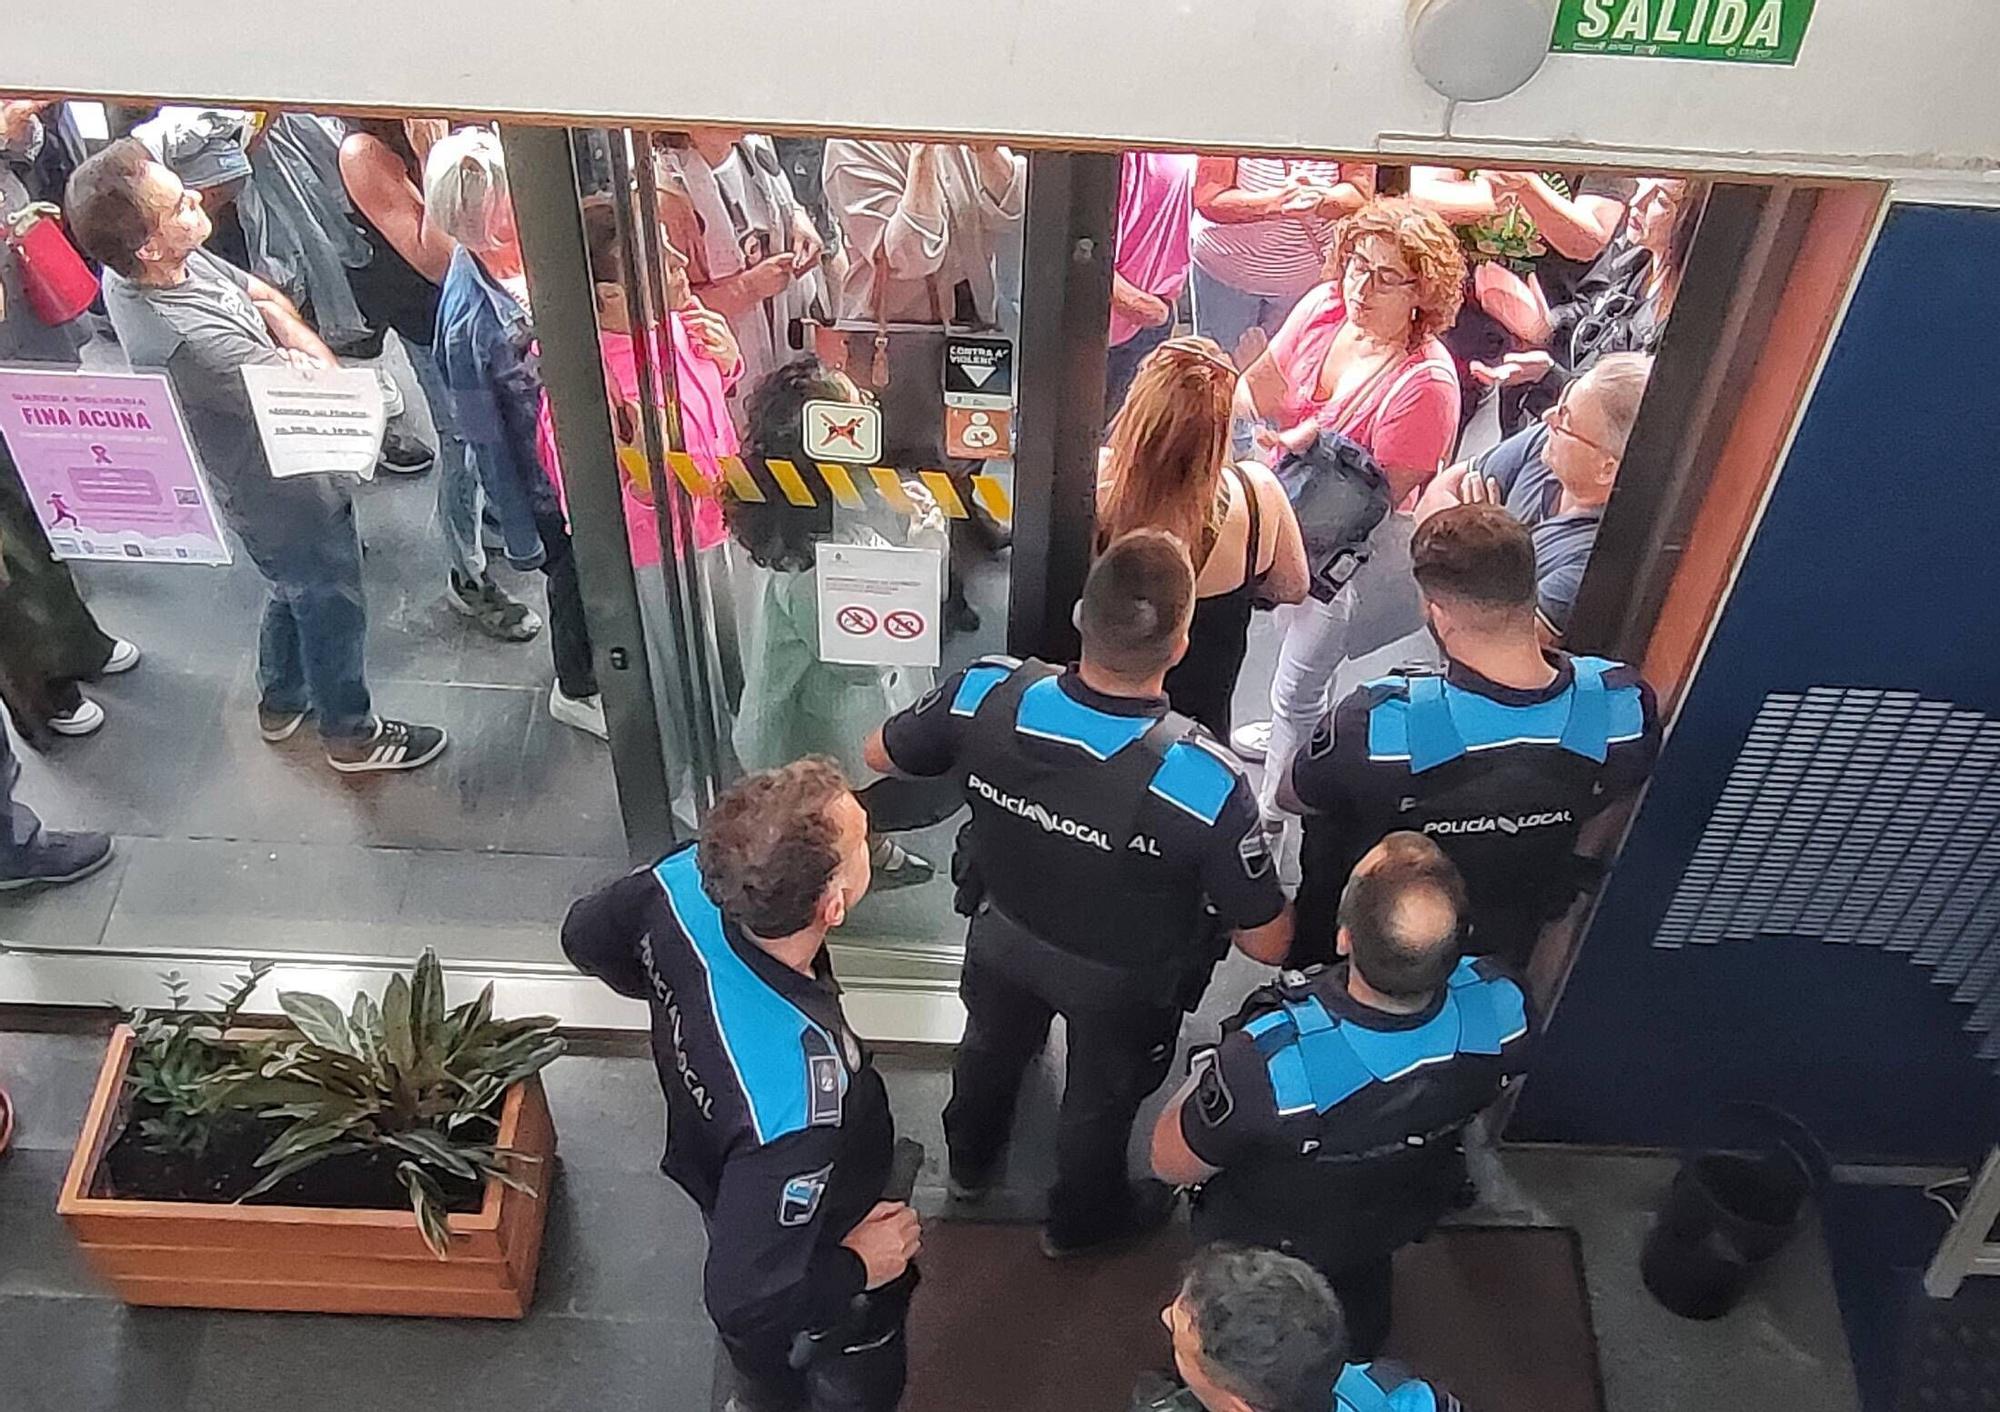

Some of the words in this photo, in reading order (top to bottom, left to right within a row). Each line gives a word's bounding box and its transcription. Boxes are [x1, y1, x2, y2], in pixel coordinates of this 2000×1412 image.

[1576, 0, 1782, 47] SALIDA
[949, 346, 994, 357] CONTRA
[21, 406, 72, 426] FINA
[78, 406, 152, 430] ACUÑA
[967, 774, 1038, 821] POLICÍA
[1052, 813, 1113, 851] LOCAL
[1423, 816, 1496, 834] POLICÍA
[1518, 810, 1573, 828] LOCAL
